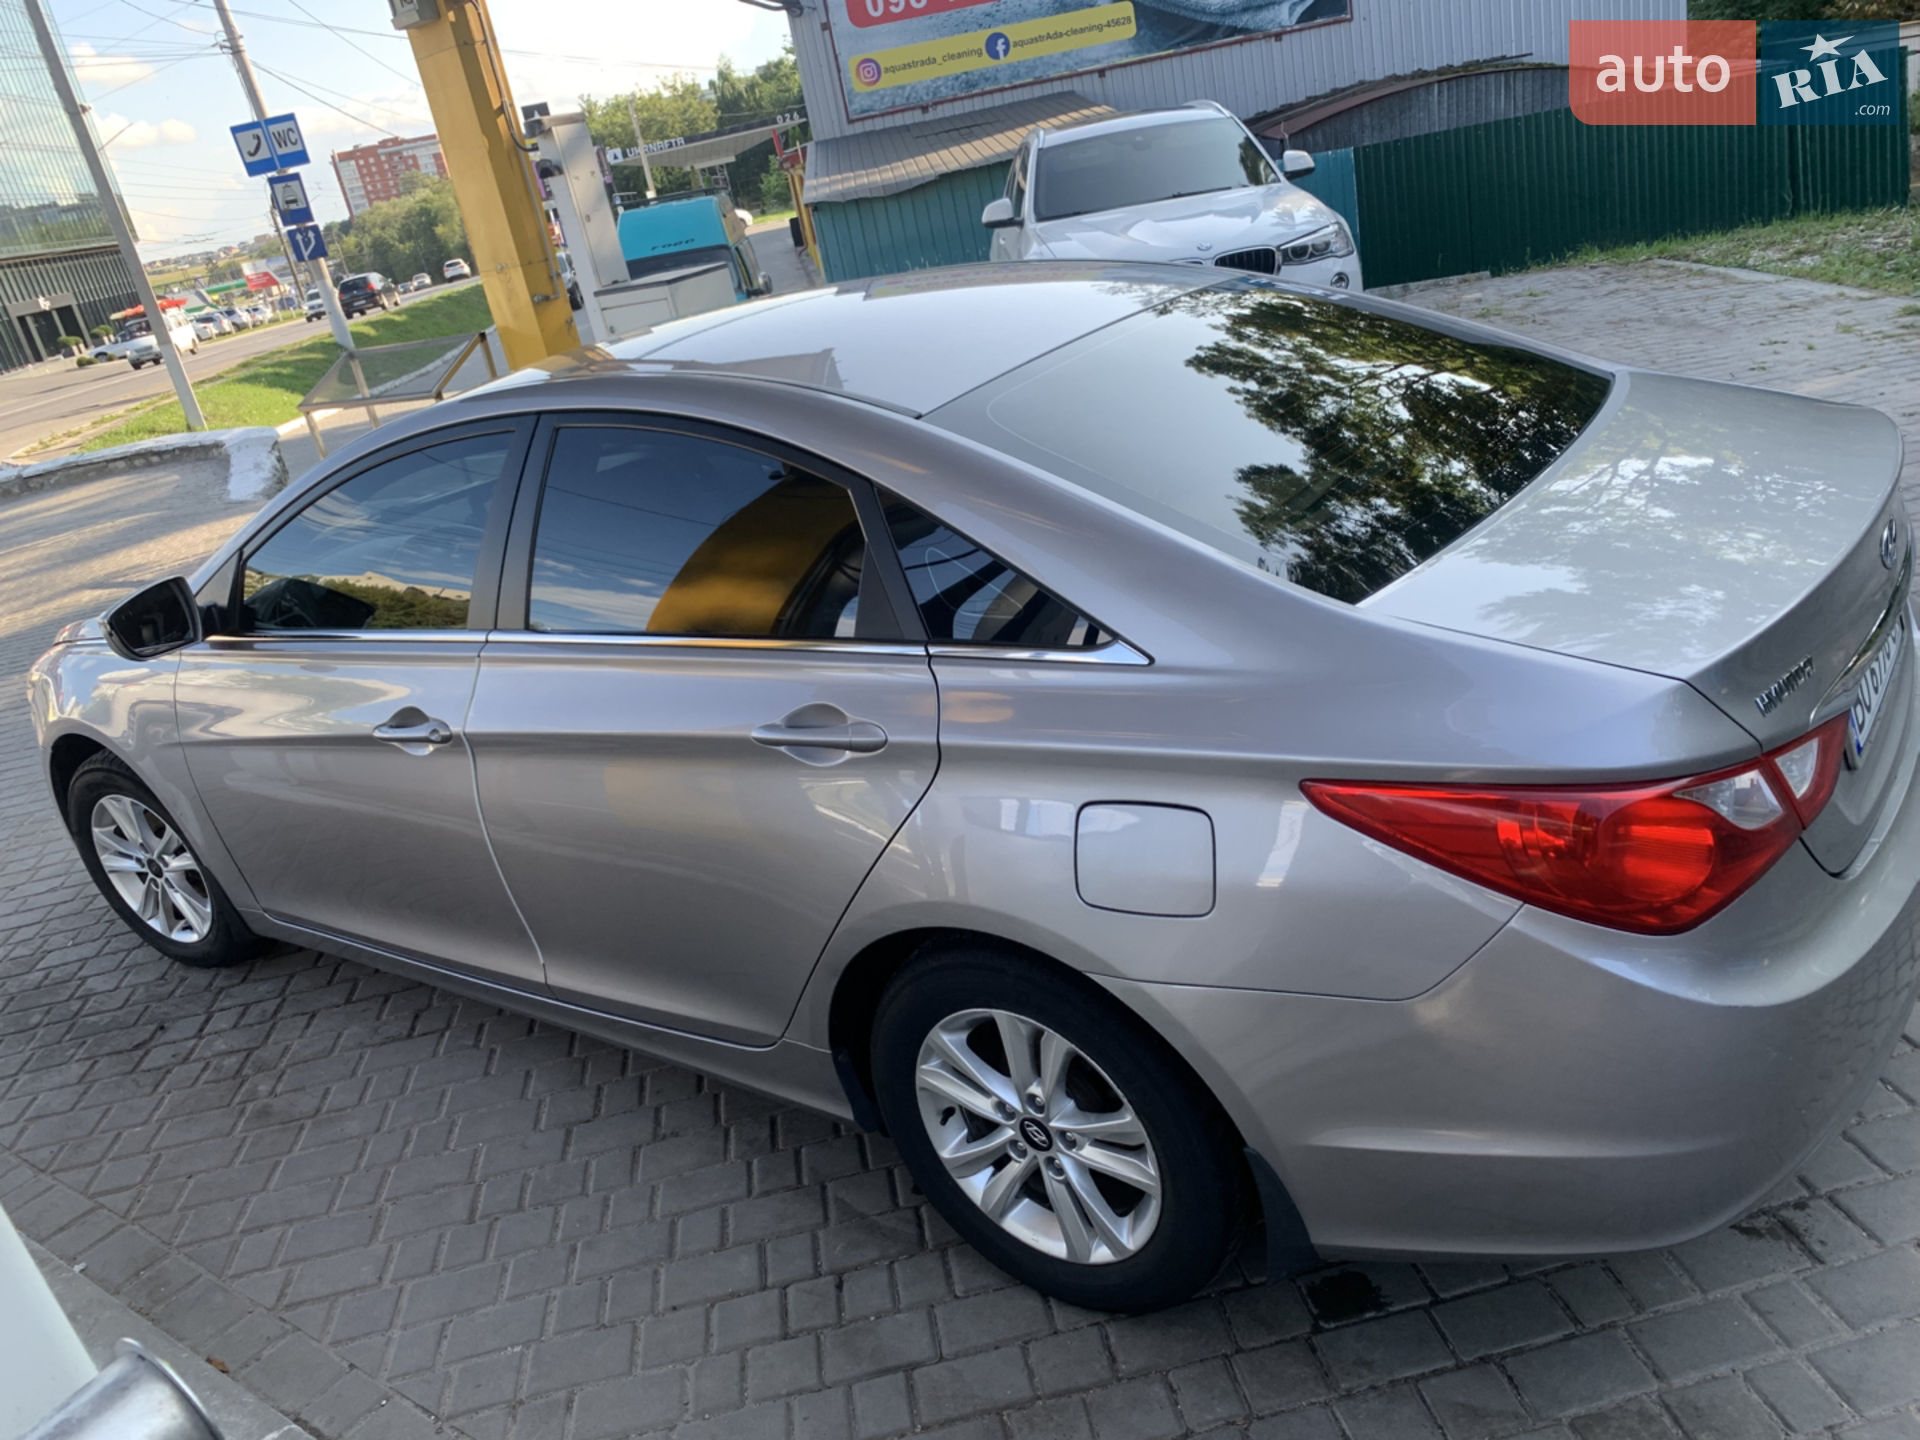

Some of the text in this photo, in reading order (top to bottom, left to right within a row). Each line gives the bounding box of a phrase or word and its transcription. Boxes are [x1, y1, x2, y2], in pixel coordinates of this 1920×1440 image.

[883, 47, 983, 74] aquastrada_cleaning
[776, 113, 800, 124] 026
[272, 127, 298, 149] WC
